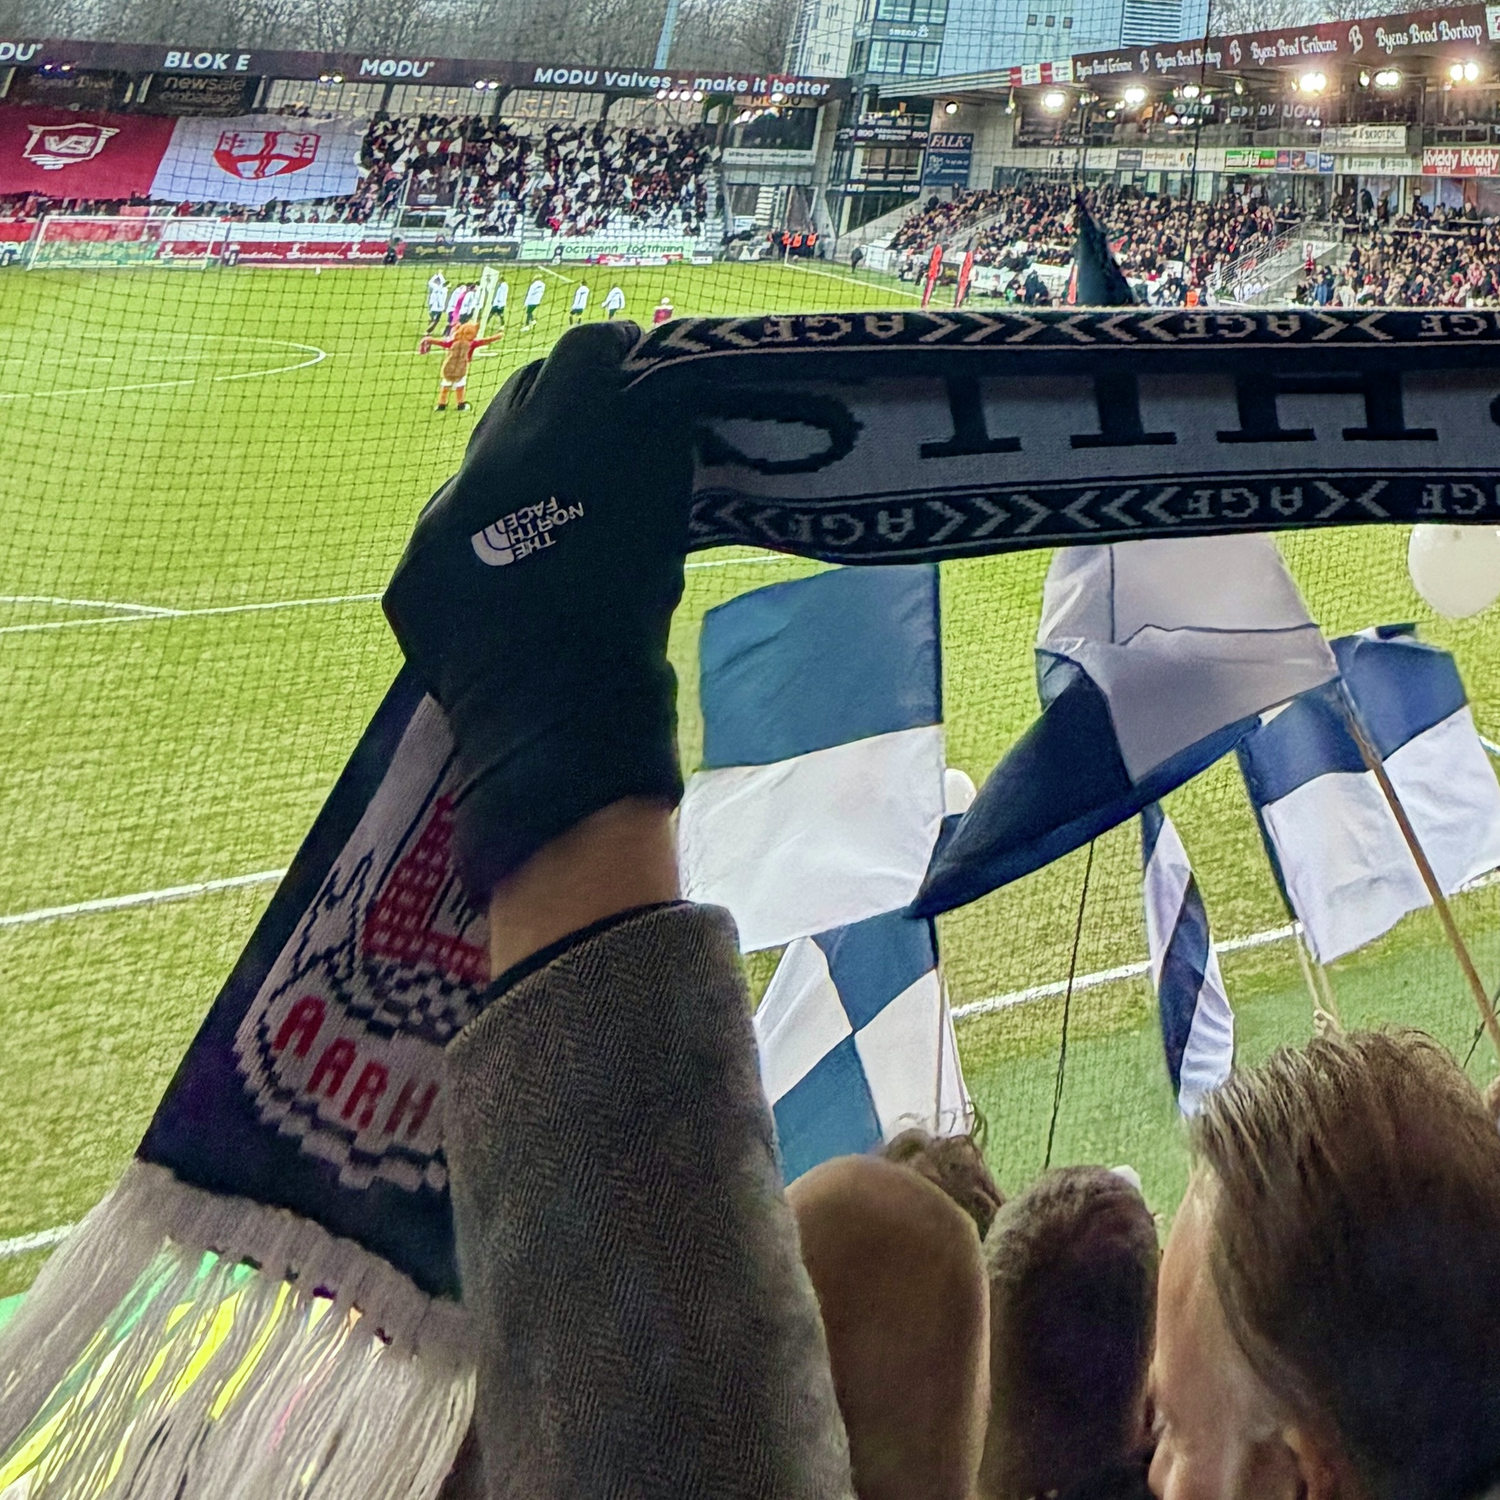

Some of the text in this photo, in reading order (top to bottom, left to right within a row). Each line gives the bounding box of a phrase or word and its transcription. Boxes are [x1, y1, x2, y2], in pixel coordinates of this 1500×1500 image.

[164, 51, 251, 71] BLOK E
[359, 59, 430, 77] MODU
[534, 68, 598, 85] MODU
[604, 71, 672, 88] Valves
[694, 76, 748, 92] make
[753, 77, 768, 93] it
[771, 79, 830, 95] better
[1180, 313, 1302, 341] AGF
[504, 496, 559, 531] FACE
[1182, 486, 1304, 519] AGF
[508, 501, 584, 545] NORTH
[512, 532, 557, 561] THE
[272, 995, 440, 1141] AARH
